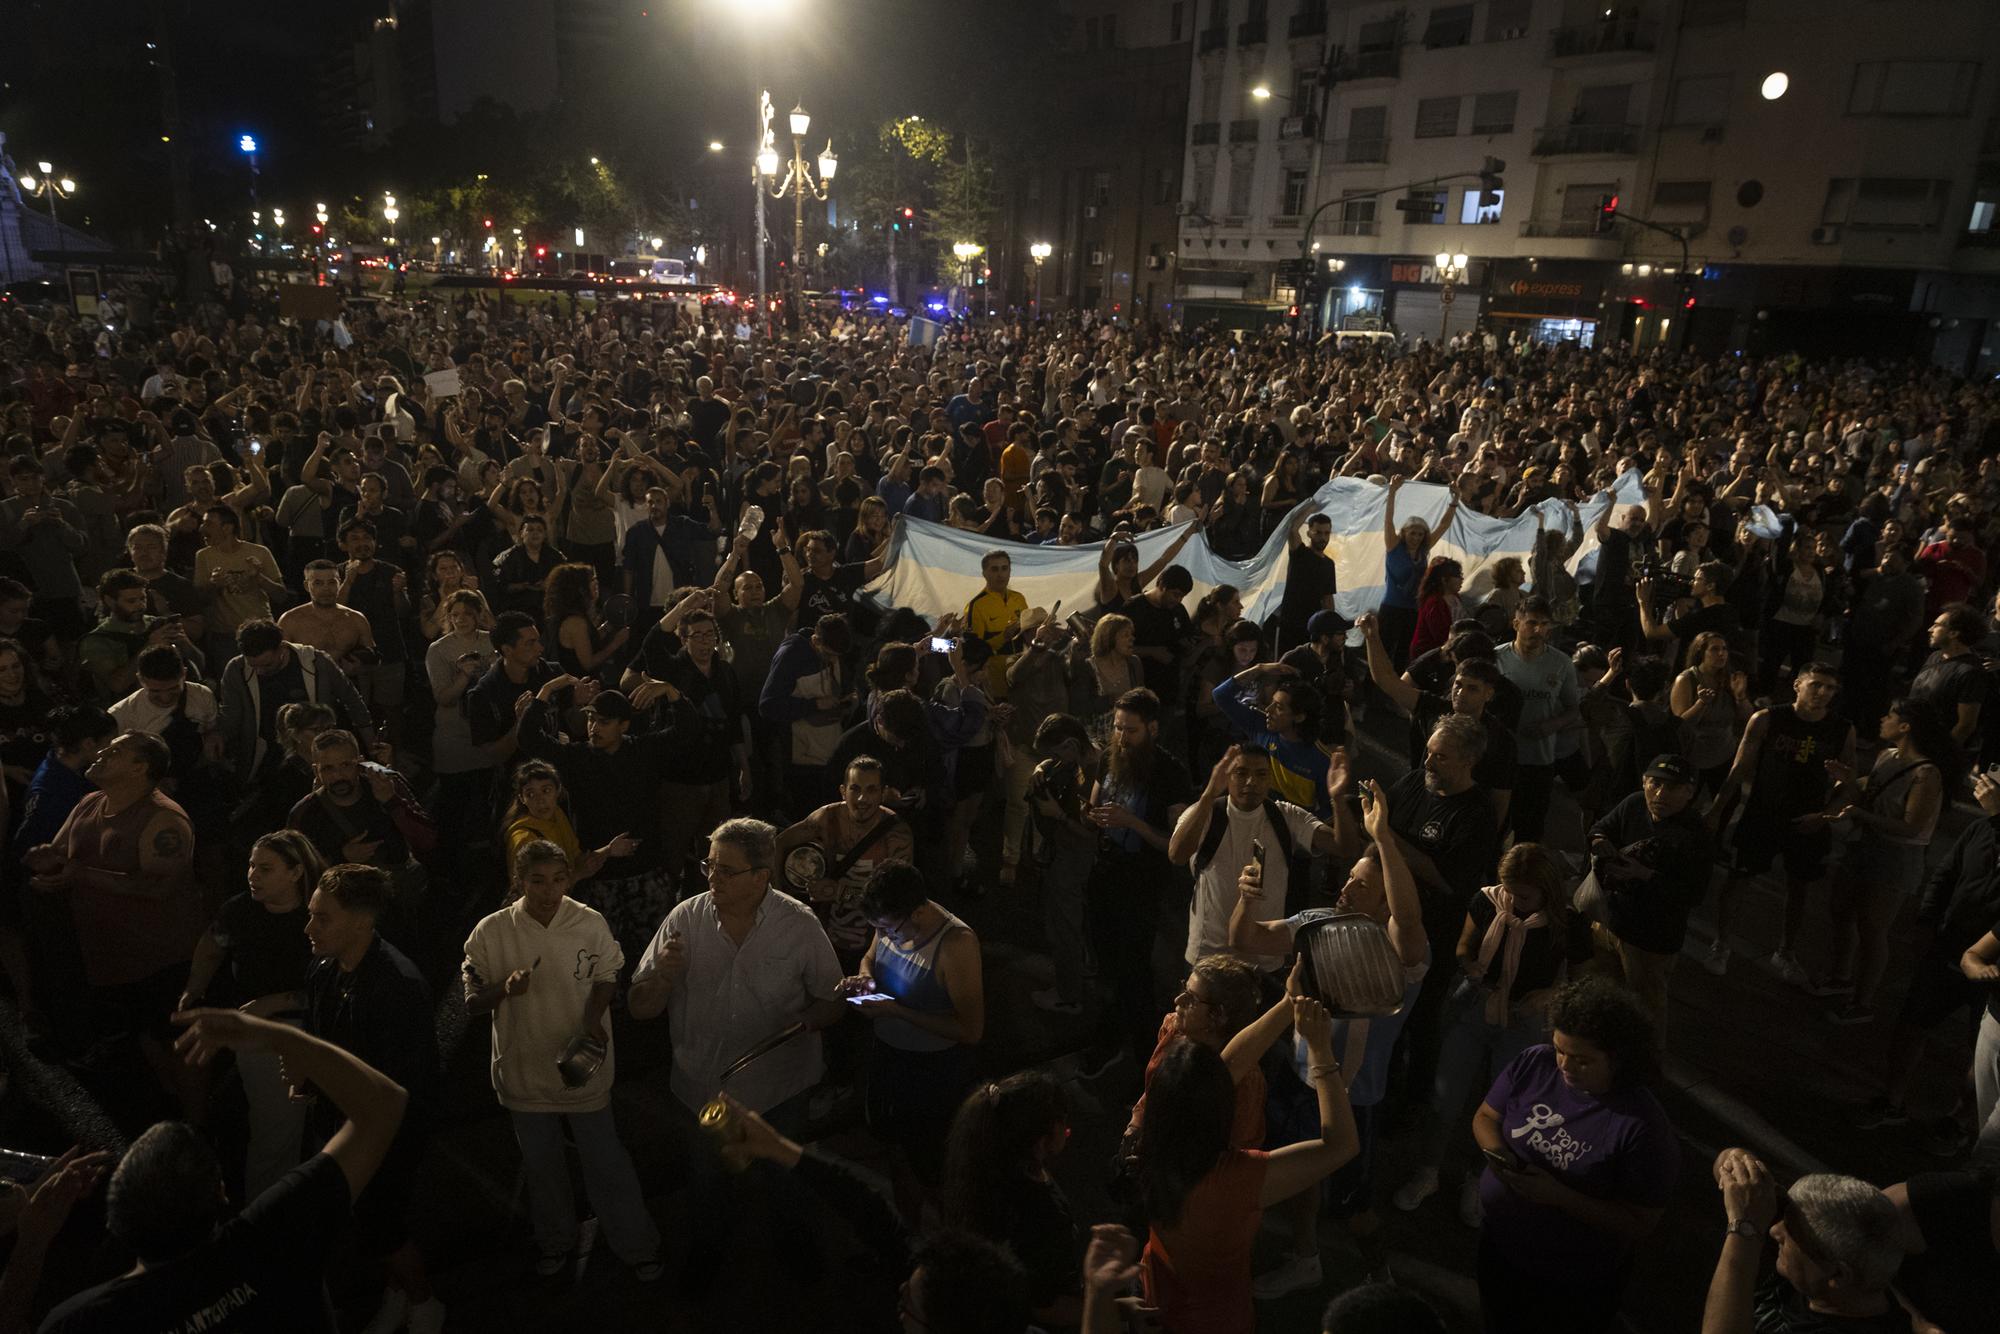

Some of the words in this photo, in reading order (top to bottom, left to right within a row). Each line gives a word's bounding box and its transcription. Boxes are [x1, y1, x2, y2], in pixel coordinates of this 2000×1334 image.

[1391, 263, 1420, 283] BIG
[1420, 265, 1469, 285] PIA
[1530, 281, 1584, 296] express
